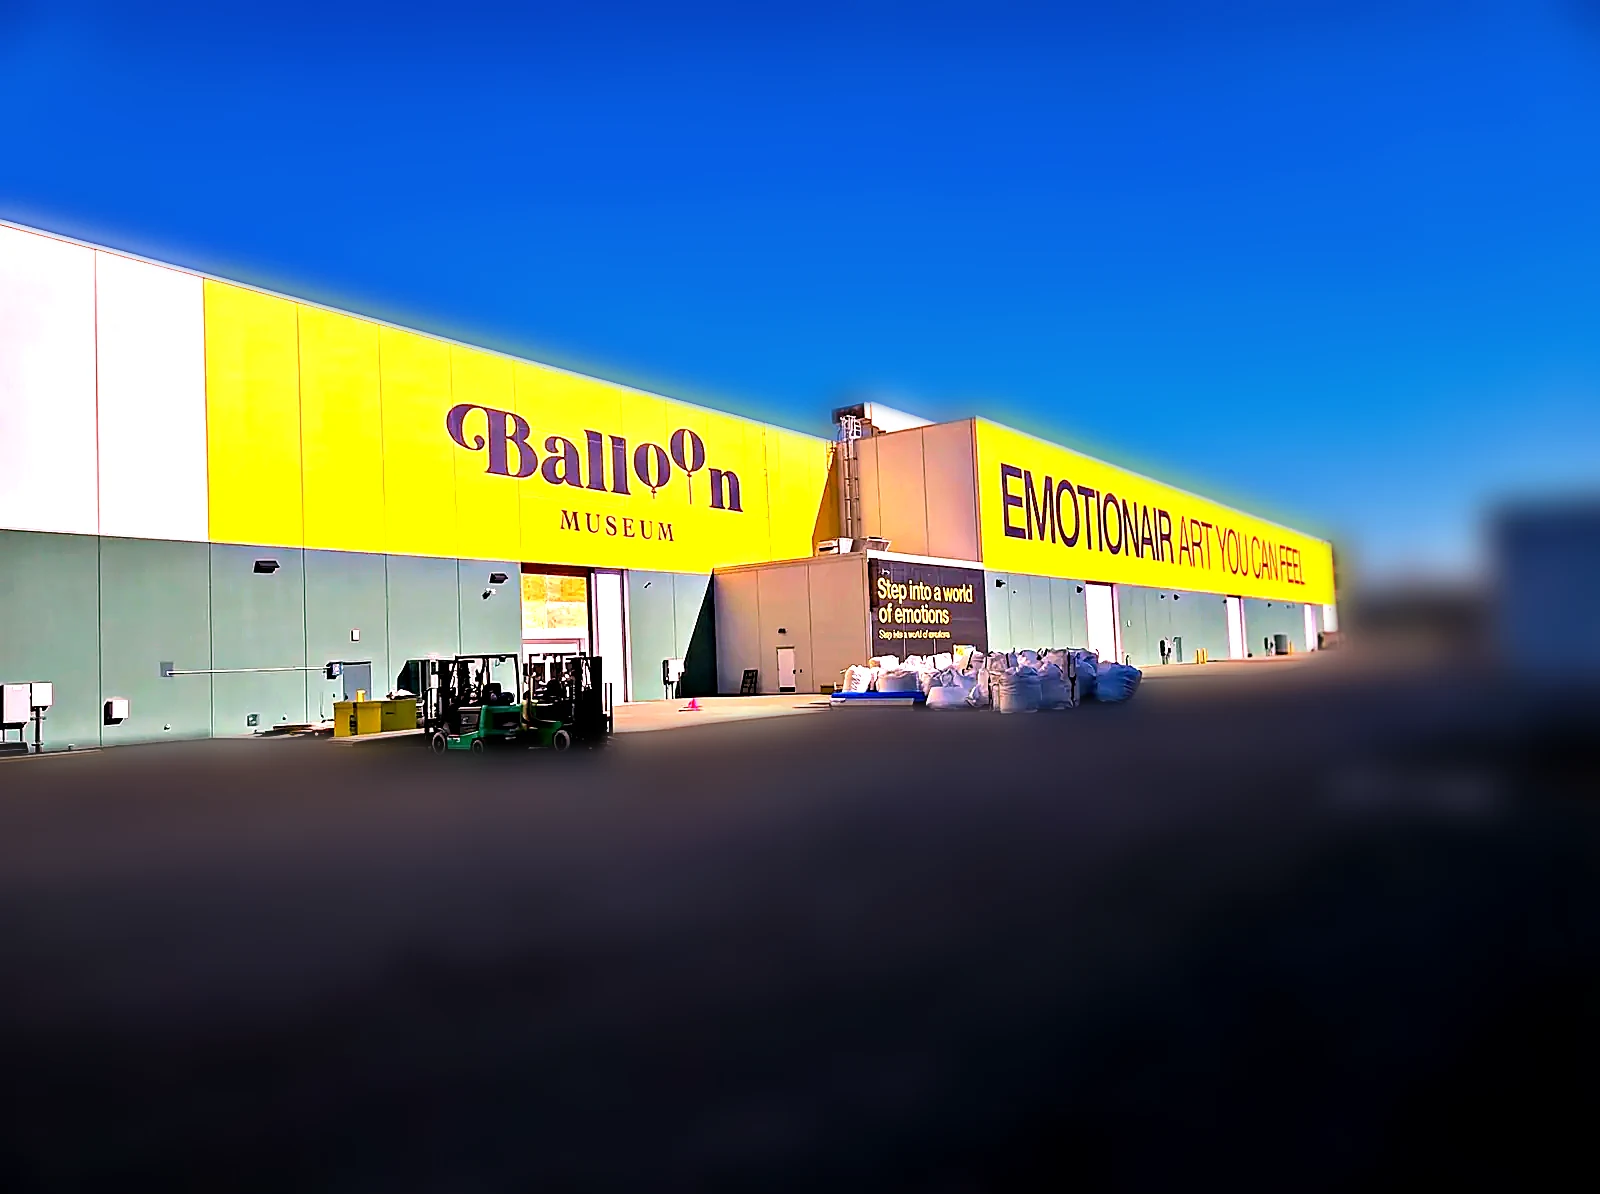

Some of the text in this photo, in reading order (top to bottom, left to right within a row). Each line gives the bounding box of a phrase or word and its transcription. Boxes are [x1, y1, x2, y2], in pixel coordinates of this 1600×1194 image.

[446, 403, 743, 512] Balloon
[560, 510, 674, 542] MUSEUM
[1001, 463, 1305, 585] EMOTIONAIR ART YOU CAN FEEL
[877, 577, 973, 604] Step into a world
[878, 602, 950, 625] of emotions
